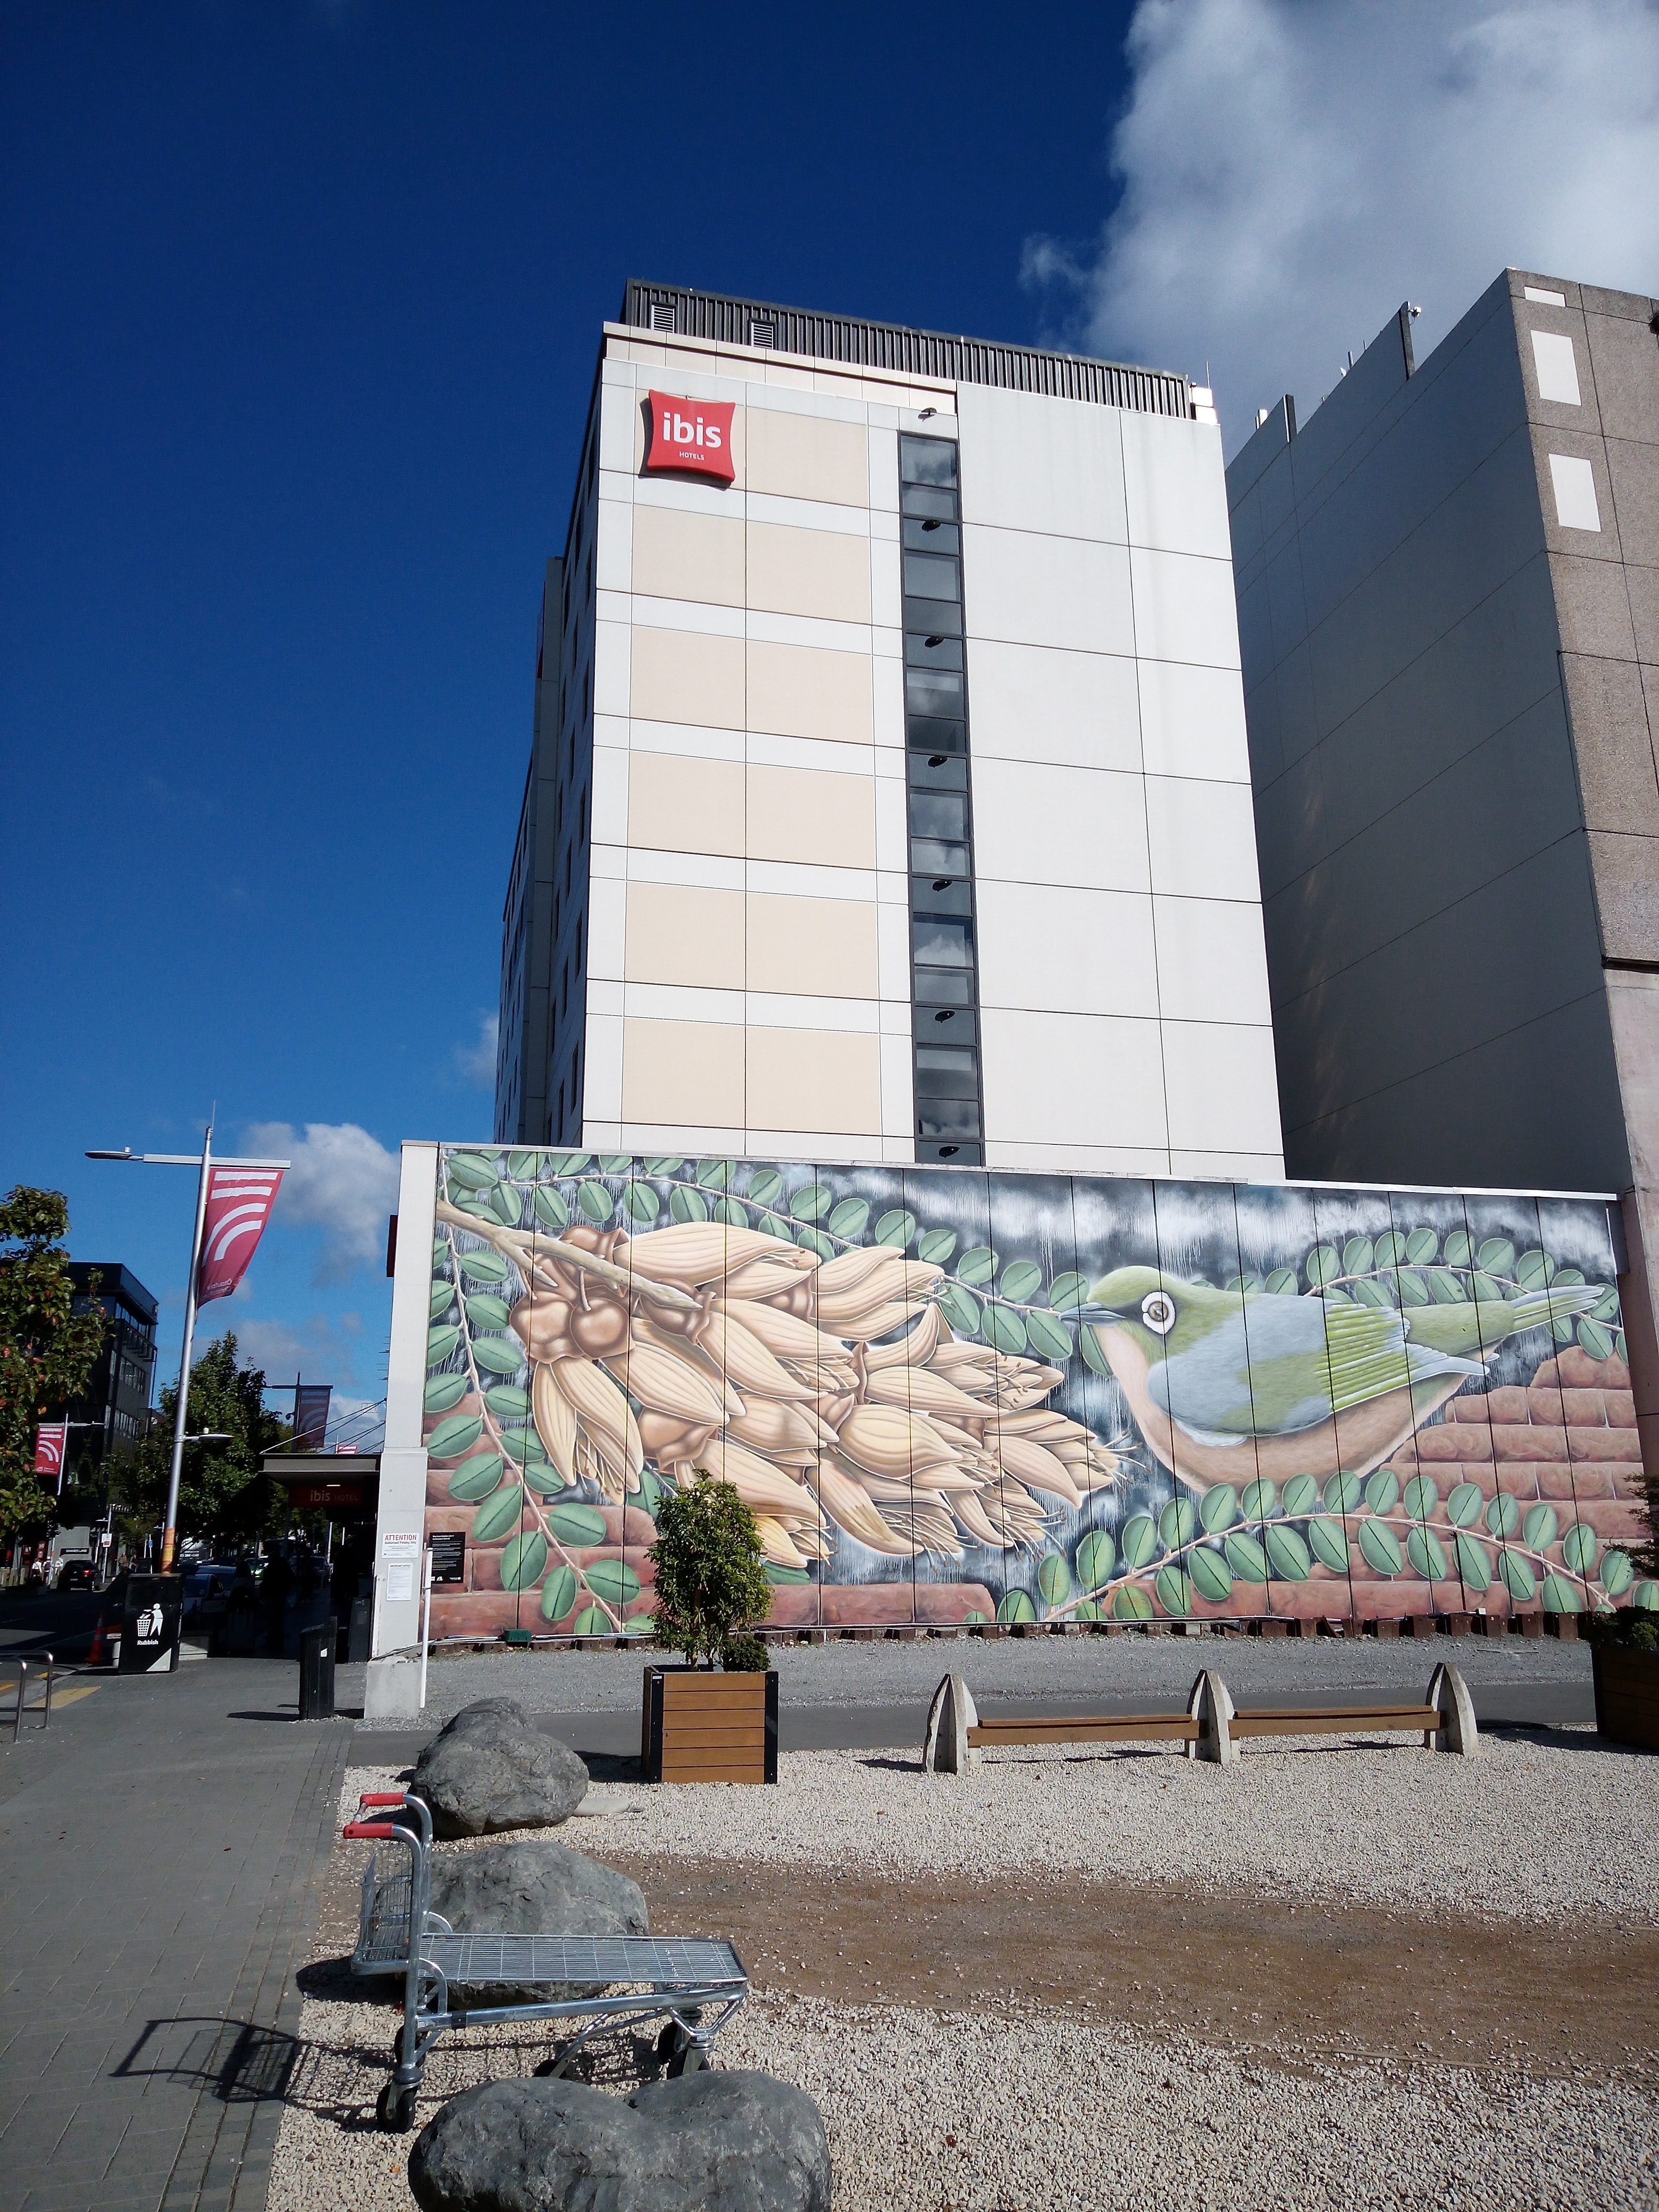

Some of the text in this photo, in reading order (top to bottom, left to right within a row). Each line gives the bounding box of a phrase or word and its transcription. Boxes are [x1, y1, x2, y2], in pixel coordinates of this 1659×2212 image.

[663, 411, 722, 448] ibis
[679, 451, 705, 460] HOTELS
[310, 1490, 330, 1501] ibis
